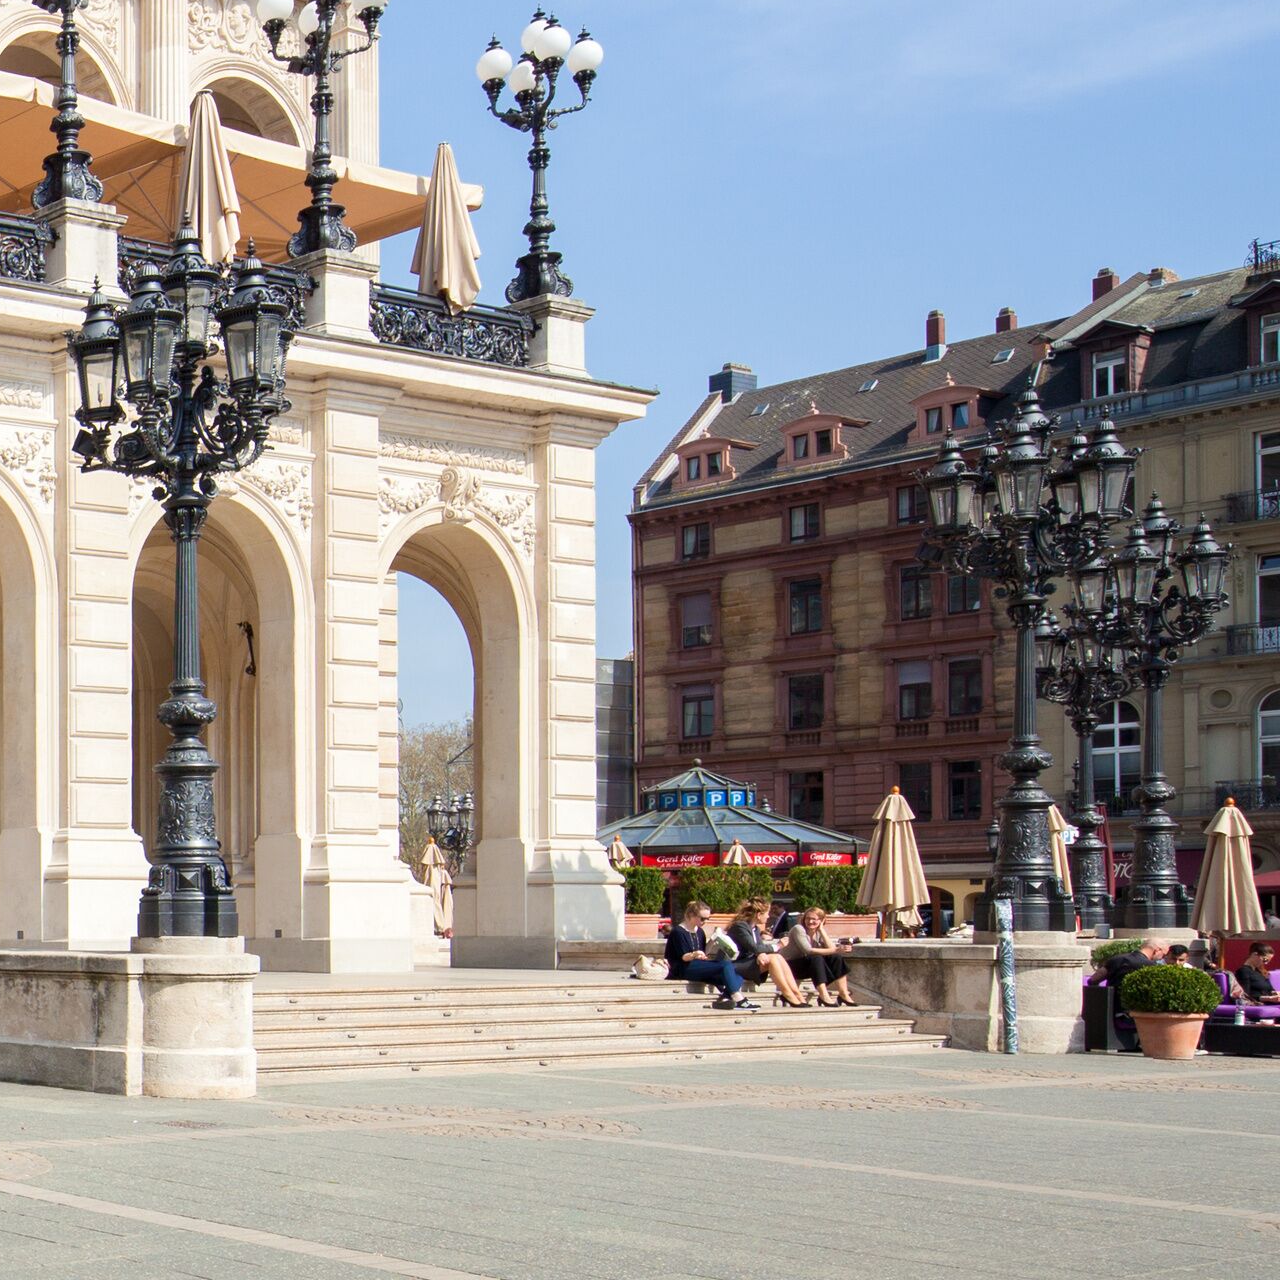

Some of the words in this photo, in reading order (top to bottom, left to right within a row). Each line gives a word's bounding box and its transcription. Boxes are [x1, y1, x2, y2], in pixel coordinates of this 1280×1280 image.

[664, 796, 674, 809] P
[686, 795, 698, 807] P
[711, 794, 722, 807] P
[732, 793, 742, 806] P
